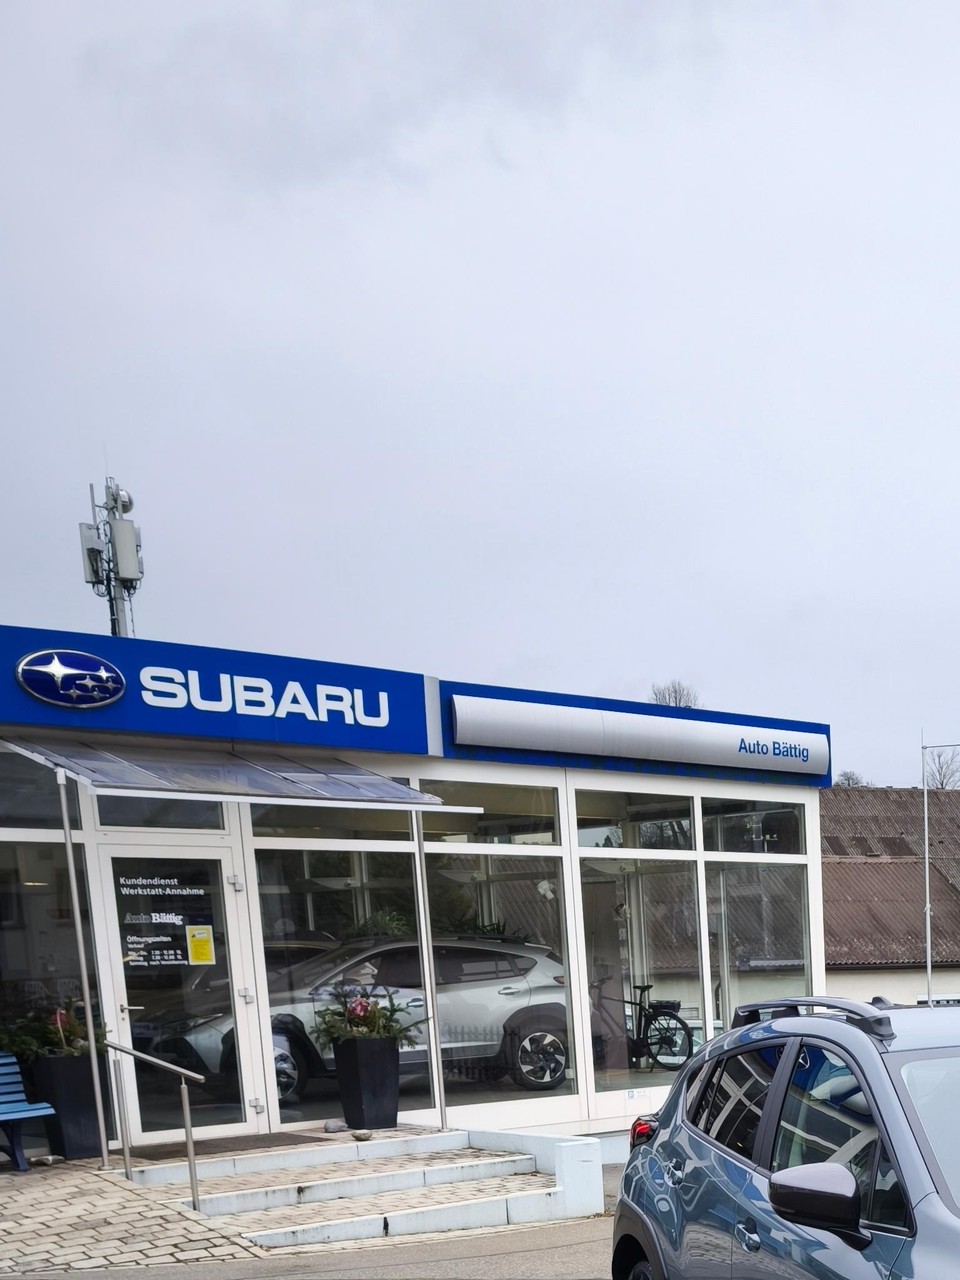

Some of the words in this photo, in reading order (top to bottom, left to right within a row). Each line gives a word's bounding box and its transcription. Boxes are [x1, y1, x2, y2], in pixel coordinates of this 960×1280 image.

[140, 666, 390, 728] SUBARU
[738, 737, 769, 755] Auto
[772, 740, 809, 763] Bättig
[119, 877, 178, 885] Kundendienst
[121, 887, 204, 896] Werkstatt-Annahme
[124, 912, 151, 923] Auto
[151, 912, 183, 926] Bättig
